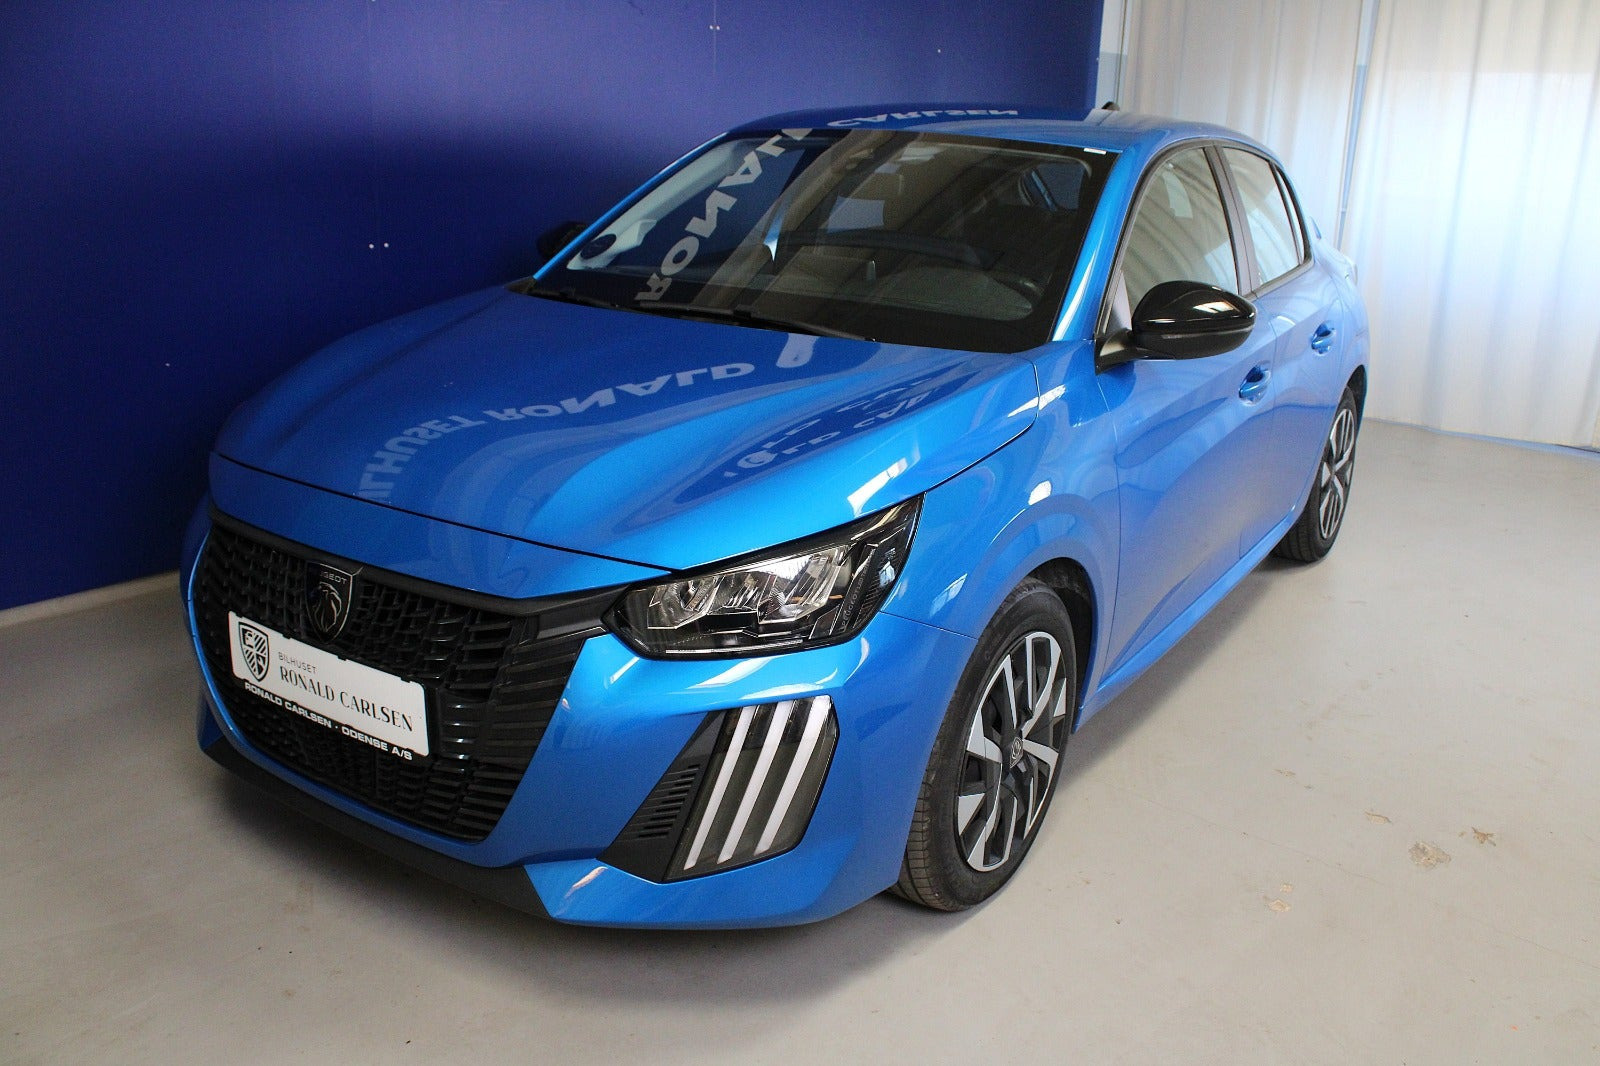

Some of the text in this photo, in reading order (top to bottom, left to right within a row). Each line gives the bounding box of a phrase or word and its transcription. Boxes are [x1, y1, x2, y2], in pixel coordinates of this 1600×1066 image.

[278, 651, 317, 674] BILHUSET
[245, 682, 282, 706] RONALD
[285, 701, 332, 729] CARLSEN
[341, 726, 388, 752] ODENSE
[391, 746, 413, 761] A/S
[280, 666, 413, 732] RONALD CARLSEN
